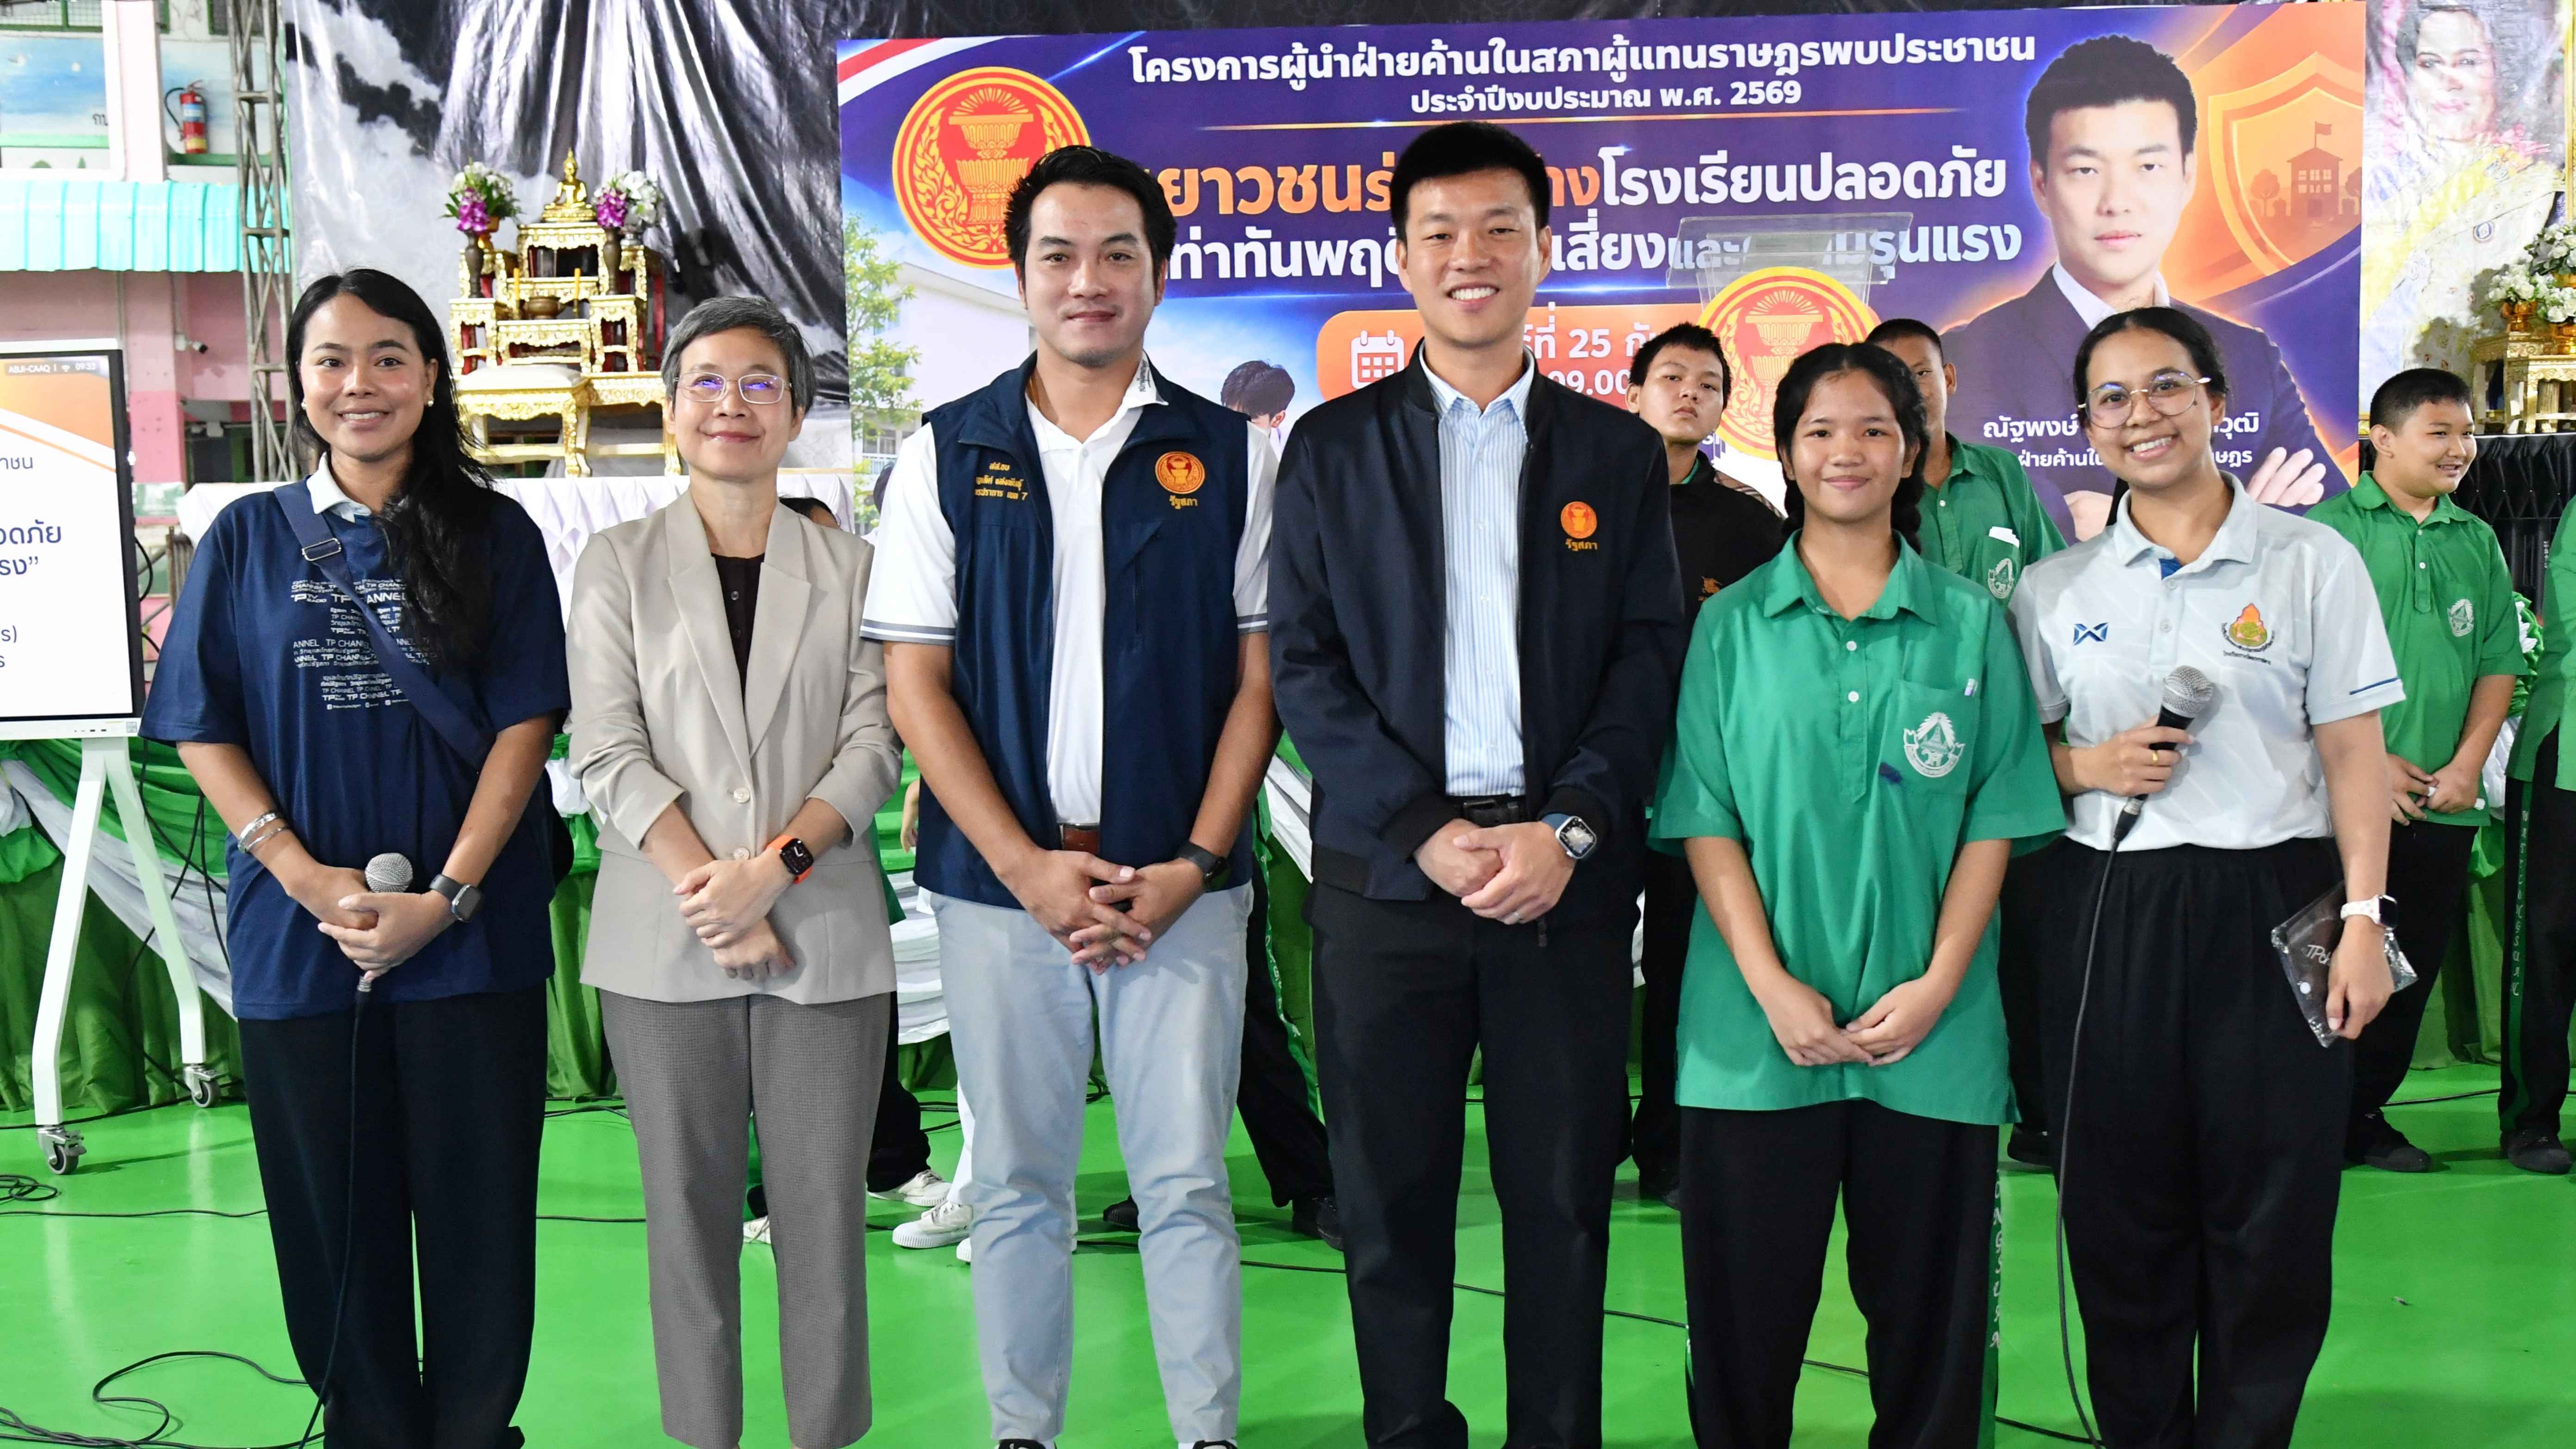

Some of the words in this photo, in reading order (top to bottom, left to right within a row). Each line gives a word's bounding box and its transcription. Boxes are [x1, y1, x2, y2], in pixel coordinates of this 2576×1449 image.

[1127, 32, 2035, 91] โครงการผู้นำฝ่ายค้านในสภาผู้แทนราษฎรพบประชาชน
[1411, 84, 1651, 113] ประจำปีงบประมาณ
[1660, 84, 1721, 106] พ.ศ.
[1730, 80, 1802, 105] 2569
[1568, 328, 1611, 358] 25
[1983, 413, 2079, 443] ณัฐพงษ์
[0, 457, 33, 470] าชน
[1022, 492, 1028, 501] 7
[1169, 495, 1198, 509] รัฐสภา
[1565, 538, 1598, 551] รัฐสภา
[367, 592, 406, 604] ANNEL
